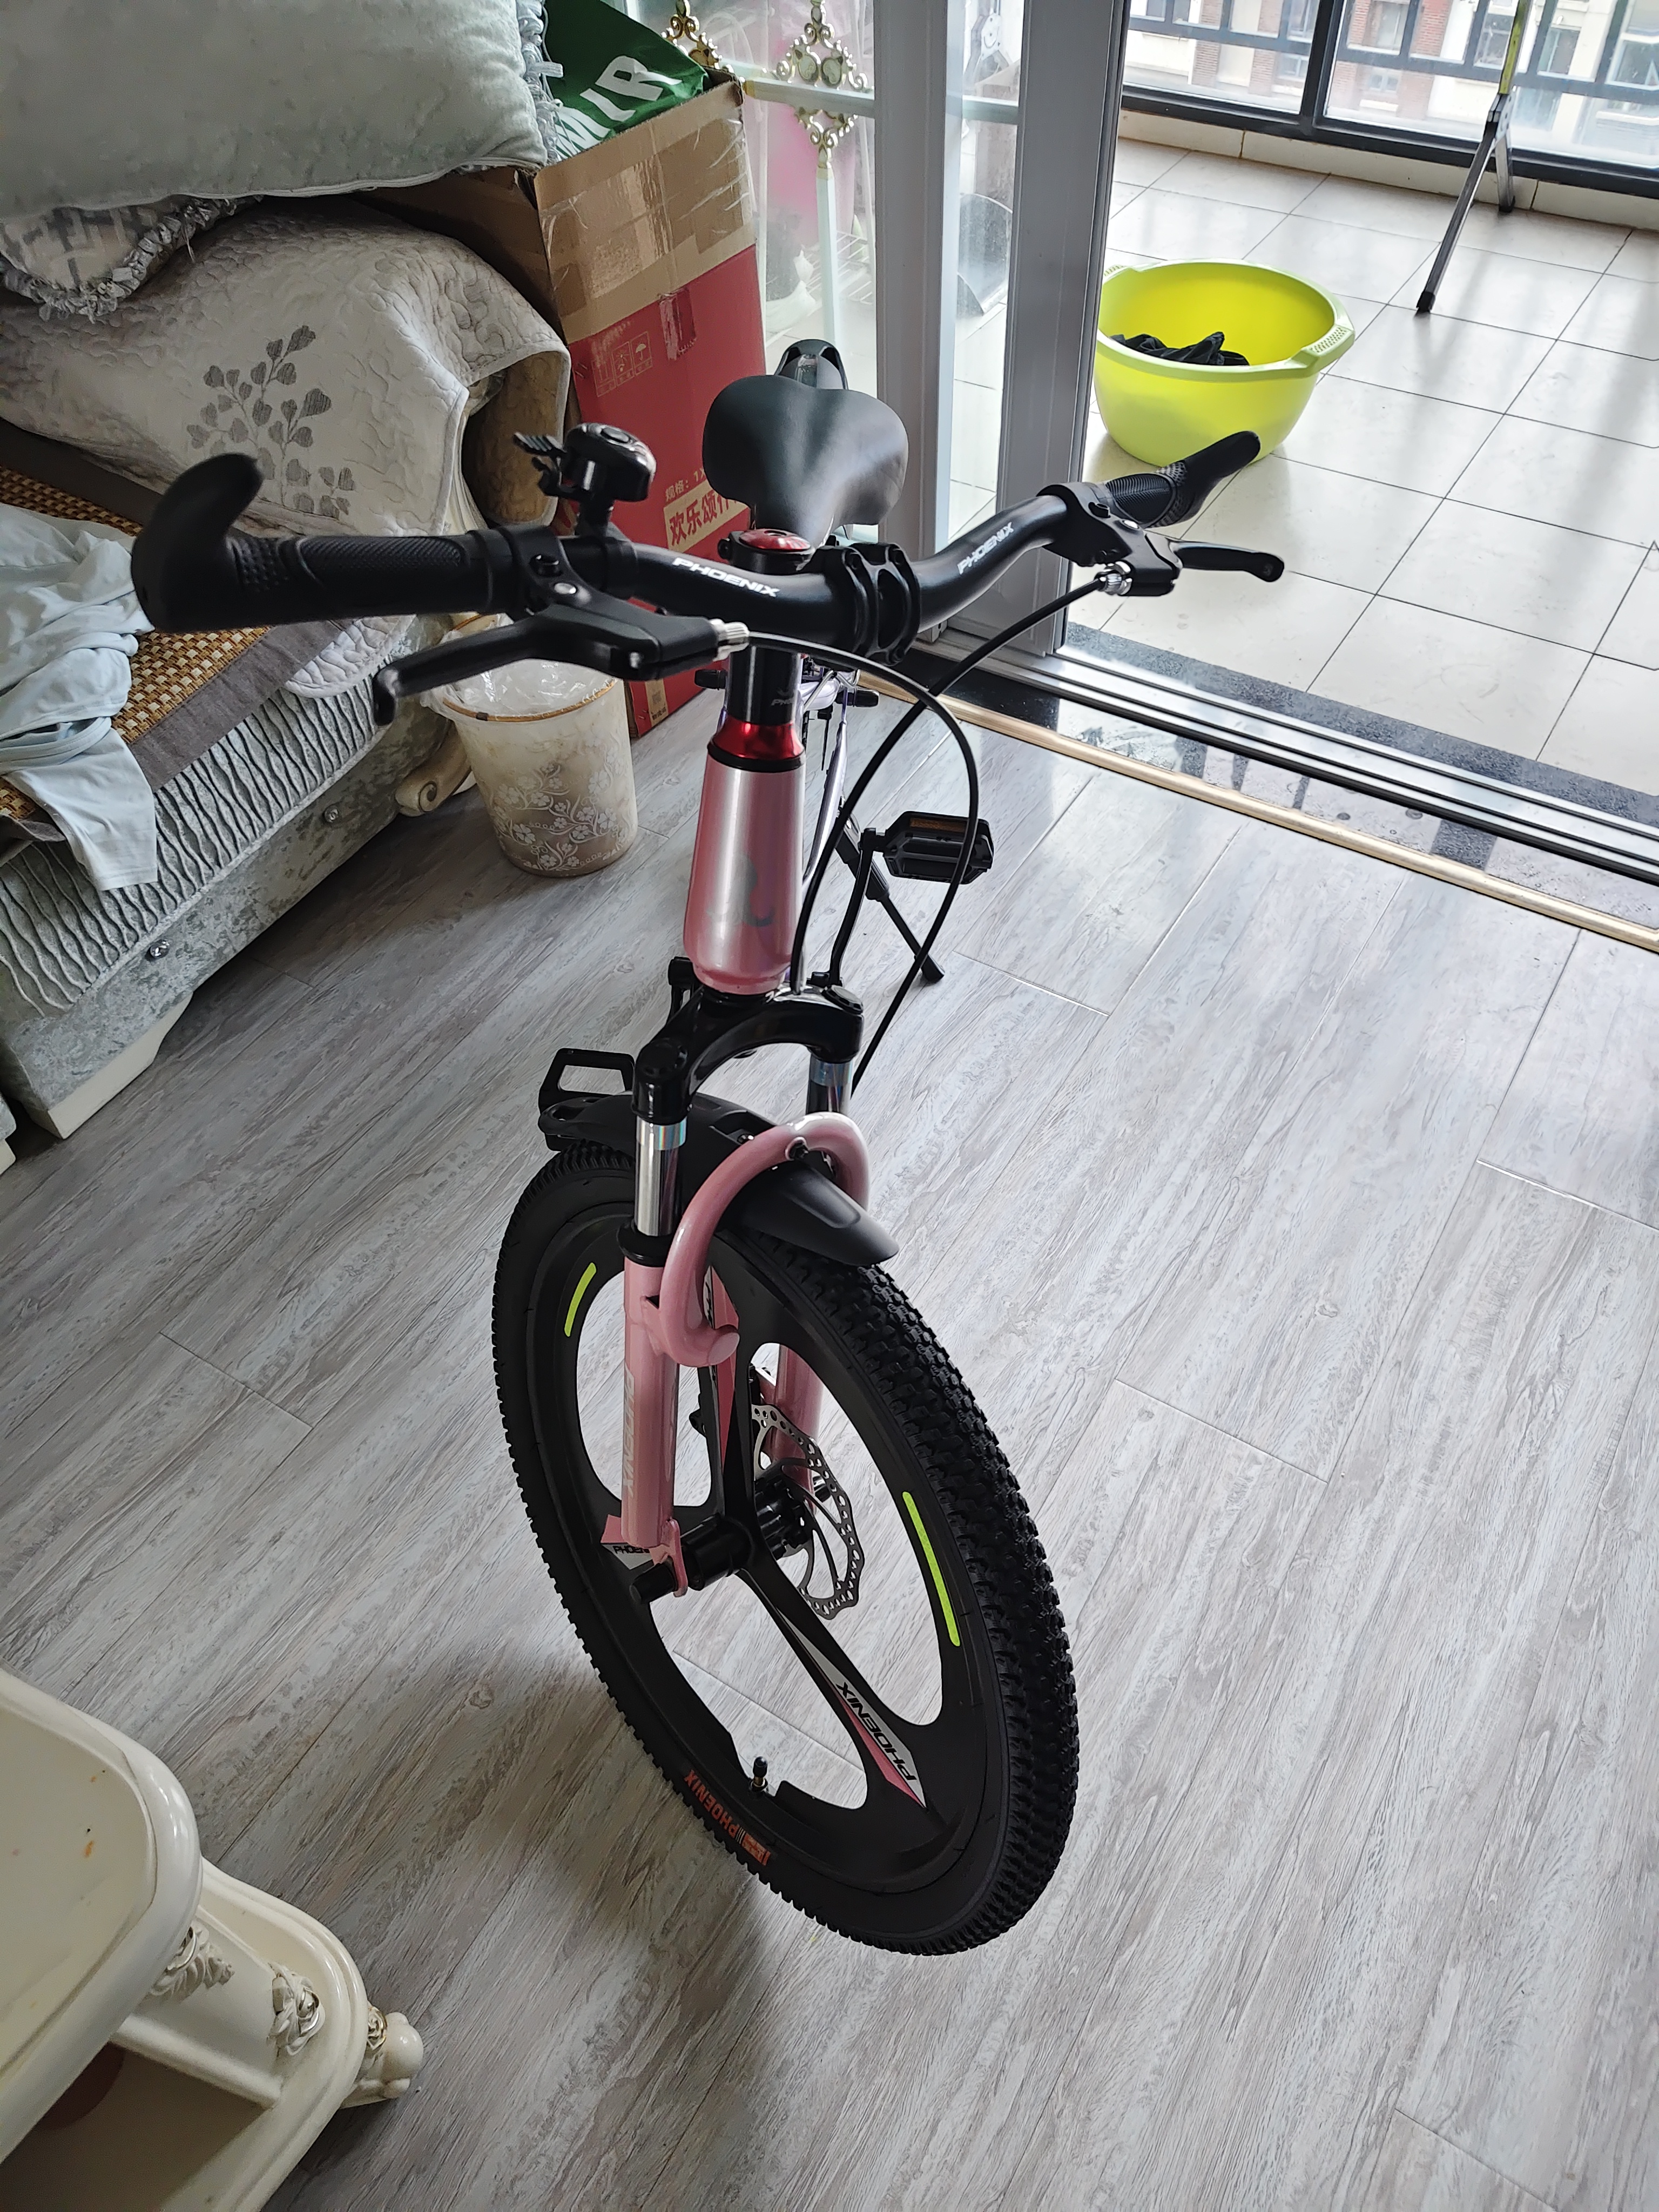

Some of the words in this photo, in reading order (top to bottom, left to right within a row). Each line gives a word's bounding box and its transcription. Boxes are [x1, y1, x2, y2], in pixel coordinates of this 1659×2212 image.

[672, 557, 780, 597] PHOENIX
[957, 522, 1014, 575] PHOENIX
[836, 1682, 917, 1782] PHOENIX
[684, 1769, 739, 1837] PHOENIX
